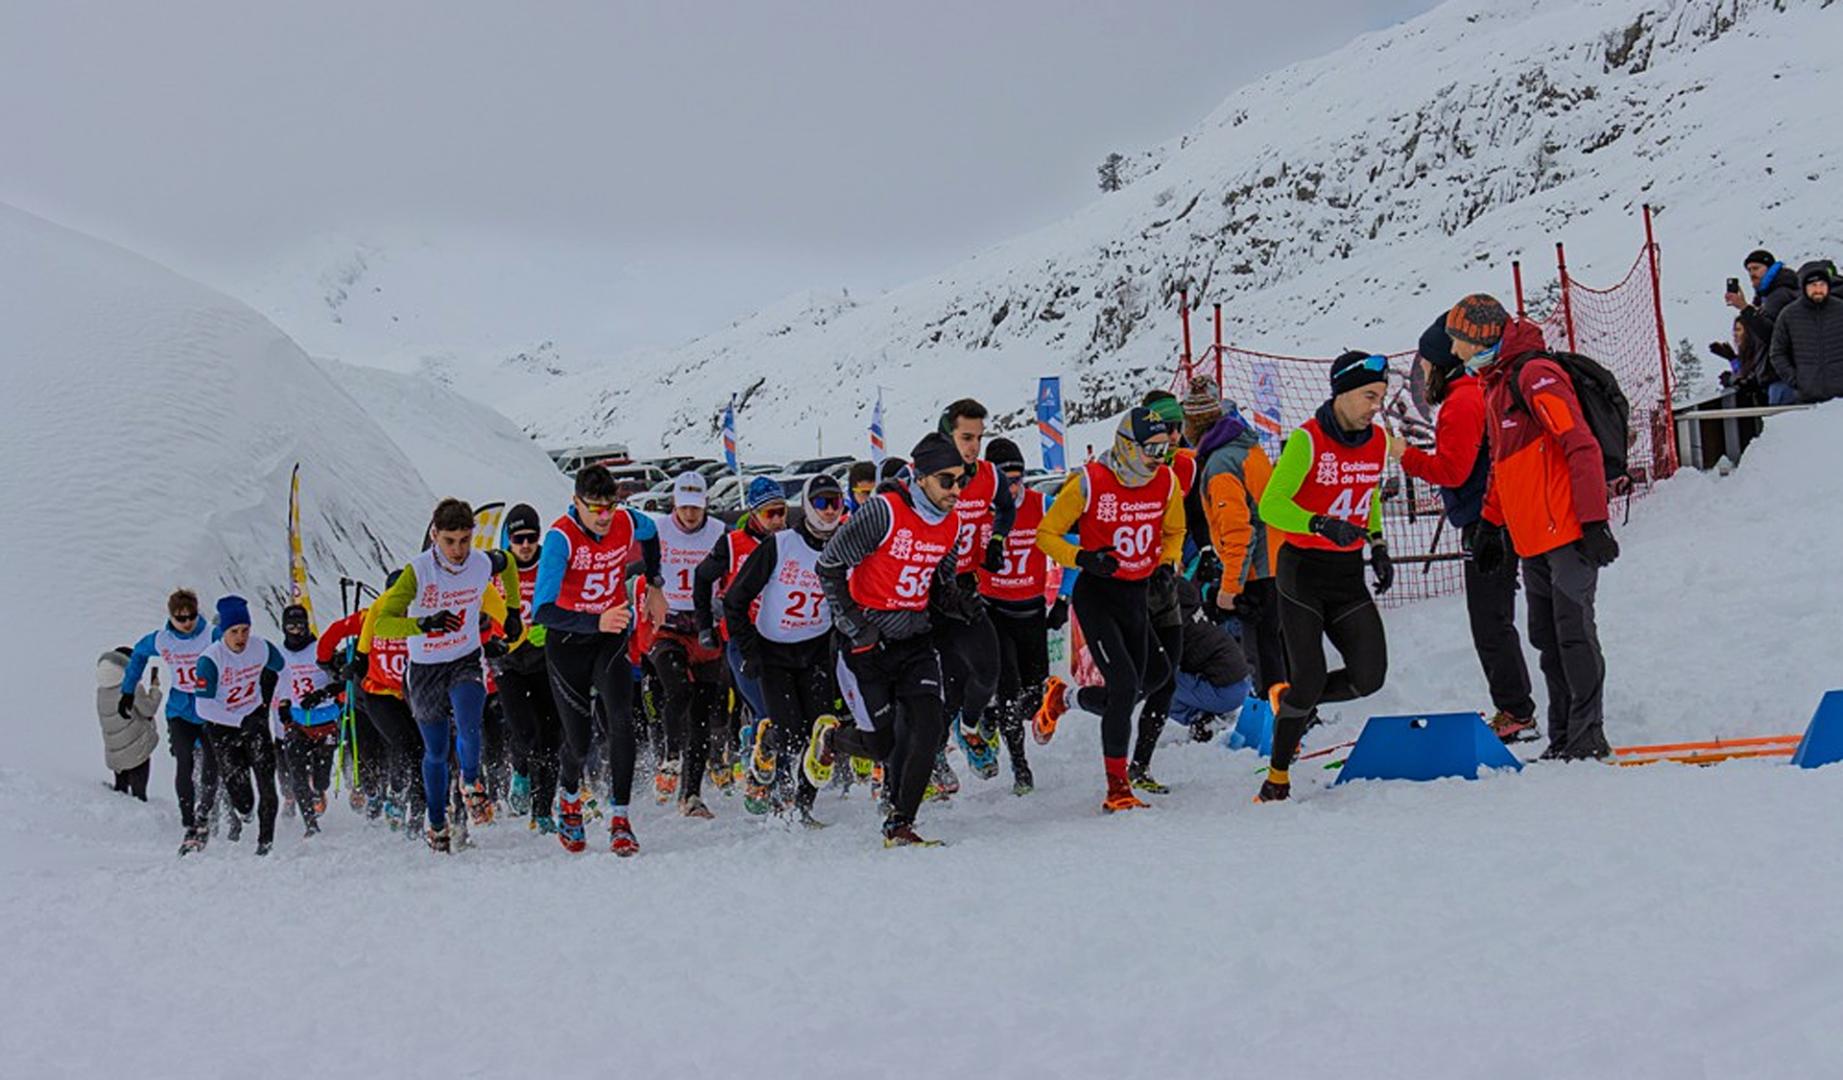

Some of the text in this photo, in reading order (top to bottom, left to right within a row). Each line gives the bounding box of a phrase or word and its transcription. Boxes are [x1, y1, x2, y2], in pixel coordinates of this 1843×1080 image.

[1340, 474, 1354, 484] de
[1120, 501, 1162, 511] Gobierno
[1327, 488, 1375, 521] 44
[1119, 513, 1134, 522] de
[957, 522, 976, 555] 3
[1113, 523, 1153, 558] 60
[912, 553, 924, 562] de
[676, 568, 692, 591] 1
[895, 565, 936, 598] 58
[519, 600, 533, 624] 2
[784, 591, 826, 618] 27
